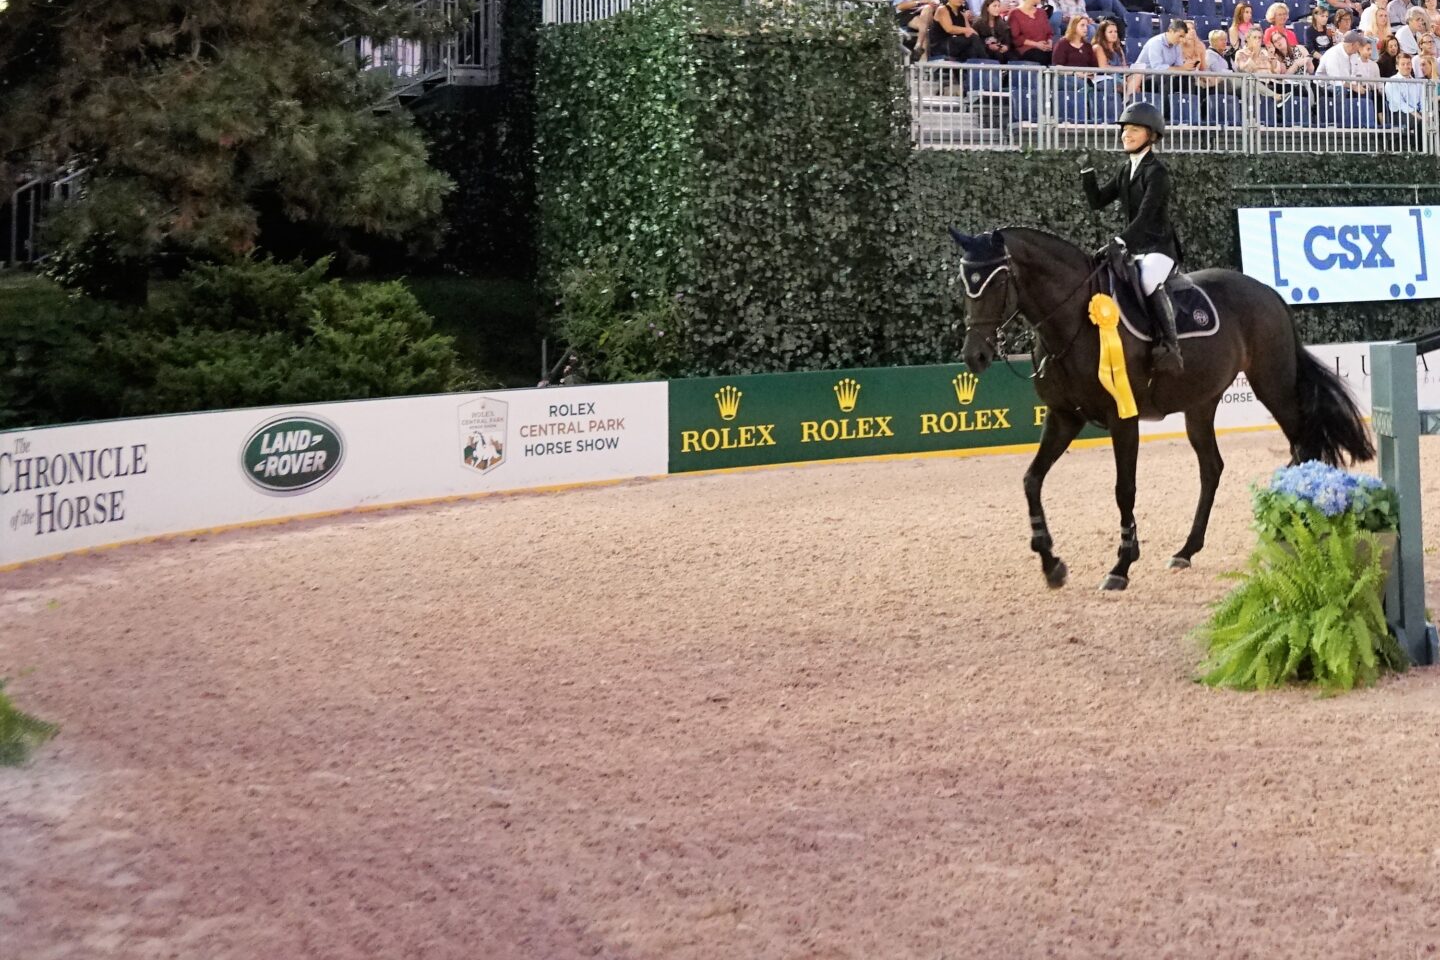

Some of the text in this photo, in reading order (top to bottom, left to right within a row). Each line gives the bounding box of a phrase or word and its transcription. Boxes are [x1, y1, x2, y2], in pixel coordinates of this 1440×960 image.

[1303, 224, 1395, 270] CSX
[549, 402, 595, 417] ROLEX
[920, 408, 1011, 434] ROLEX
[519, 418, 625, 438] CENTRAL PARK
[681, 424, 776, 453] ROLEX
[801, 416, 894, 443] ROLEX
[14, 438, 31, 454] The
[260, 429, 312, 455] LAND
[524, 437, 619, 457] HORSE SHOW
[0, 444, 148, 495] CHRONICLE
[264, 450, 327, 477] ROVER
[20, 508, 35, 527] the
[35, 490, 126, 535] HORSE
